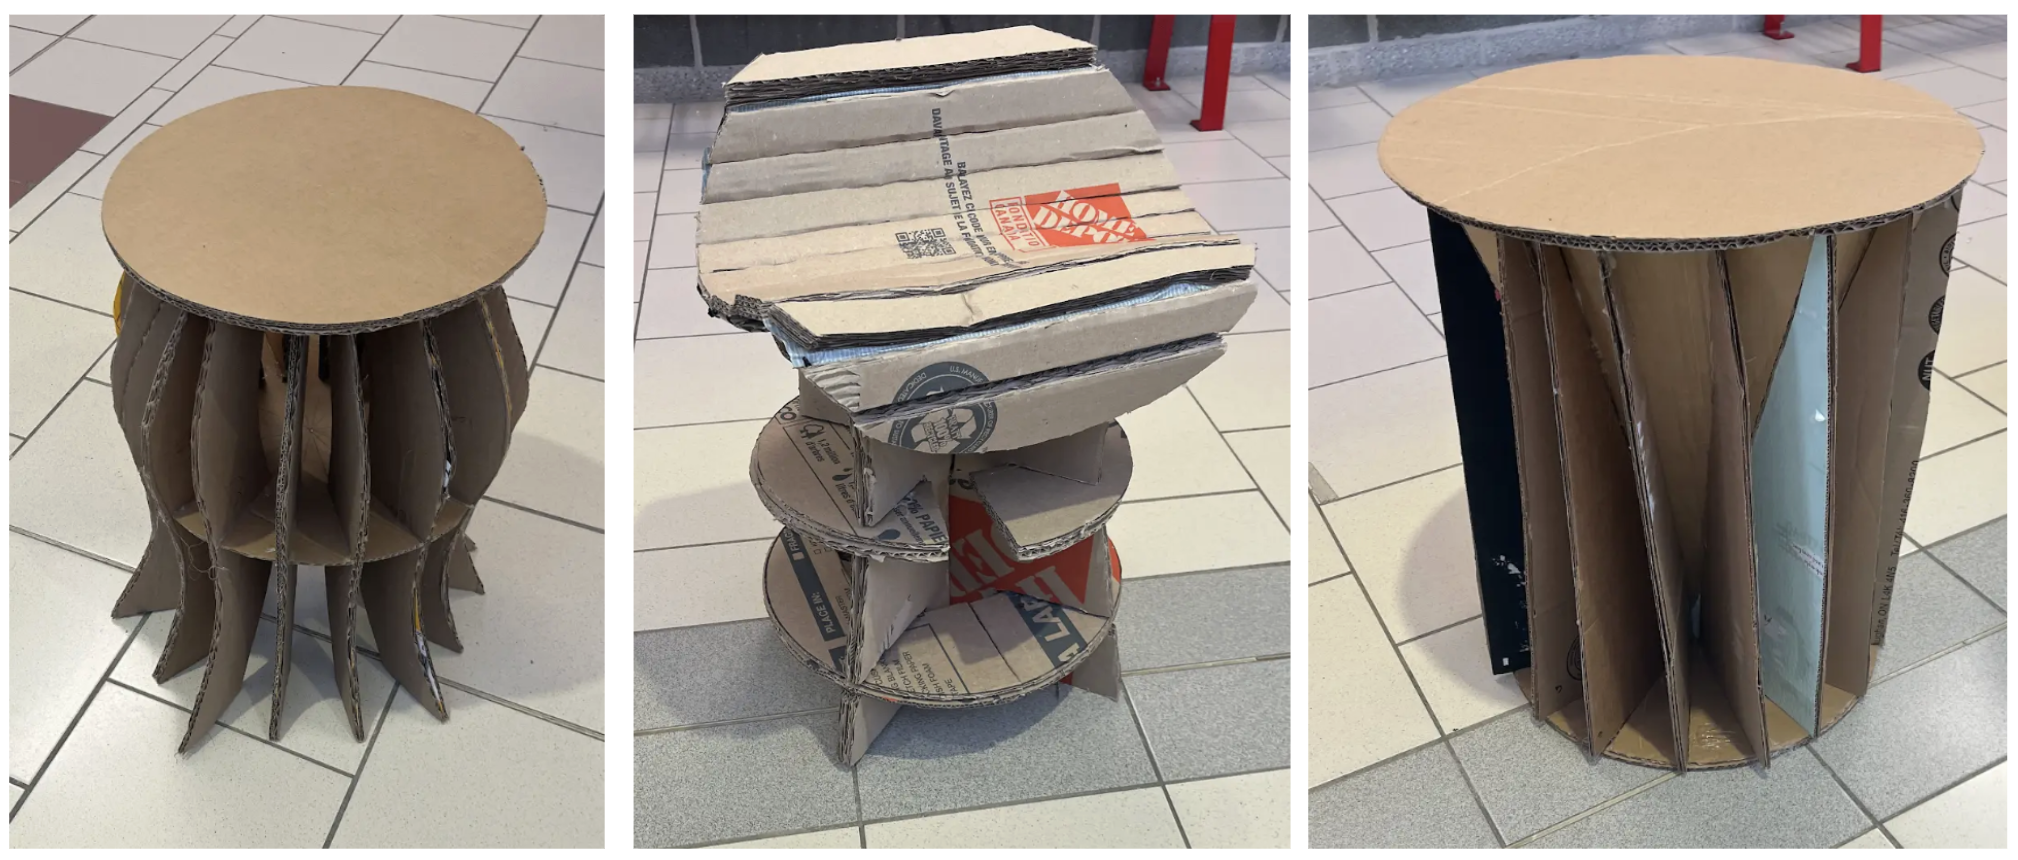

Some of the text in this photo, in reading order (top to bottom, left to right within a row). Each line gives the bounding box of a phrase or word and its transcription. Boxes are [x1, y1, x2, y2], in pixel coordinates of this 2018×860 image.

[945, 181, 961, 210] SUJET
[957, 220, 968, 231] LA
[957, 162, 972, 201] BALAYEZ
[967, 211, 983, 234] CODE
[1033, 206, 1131, 243] DEPO
[933, 416, 953, 447] 100%
[1885, 566, 1897, 583] 4N5
[1881, 584, 1892, 602] L4K
[812, 592, 836, 634] PLACE IN:
[902, 651, 918, 674] PAPER
[922, 663, 938, 685] FOAM
[903, 671, 916, 692] ETCH
